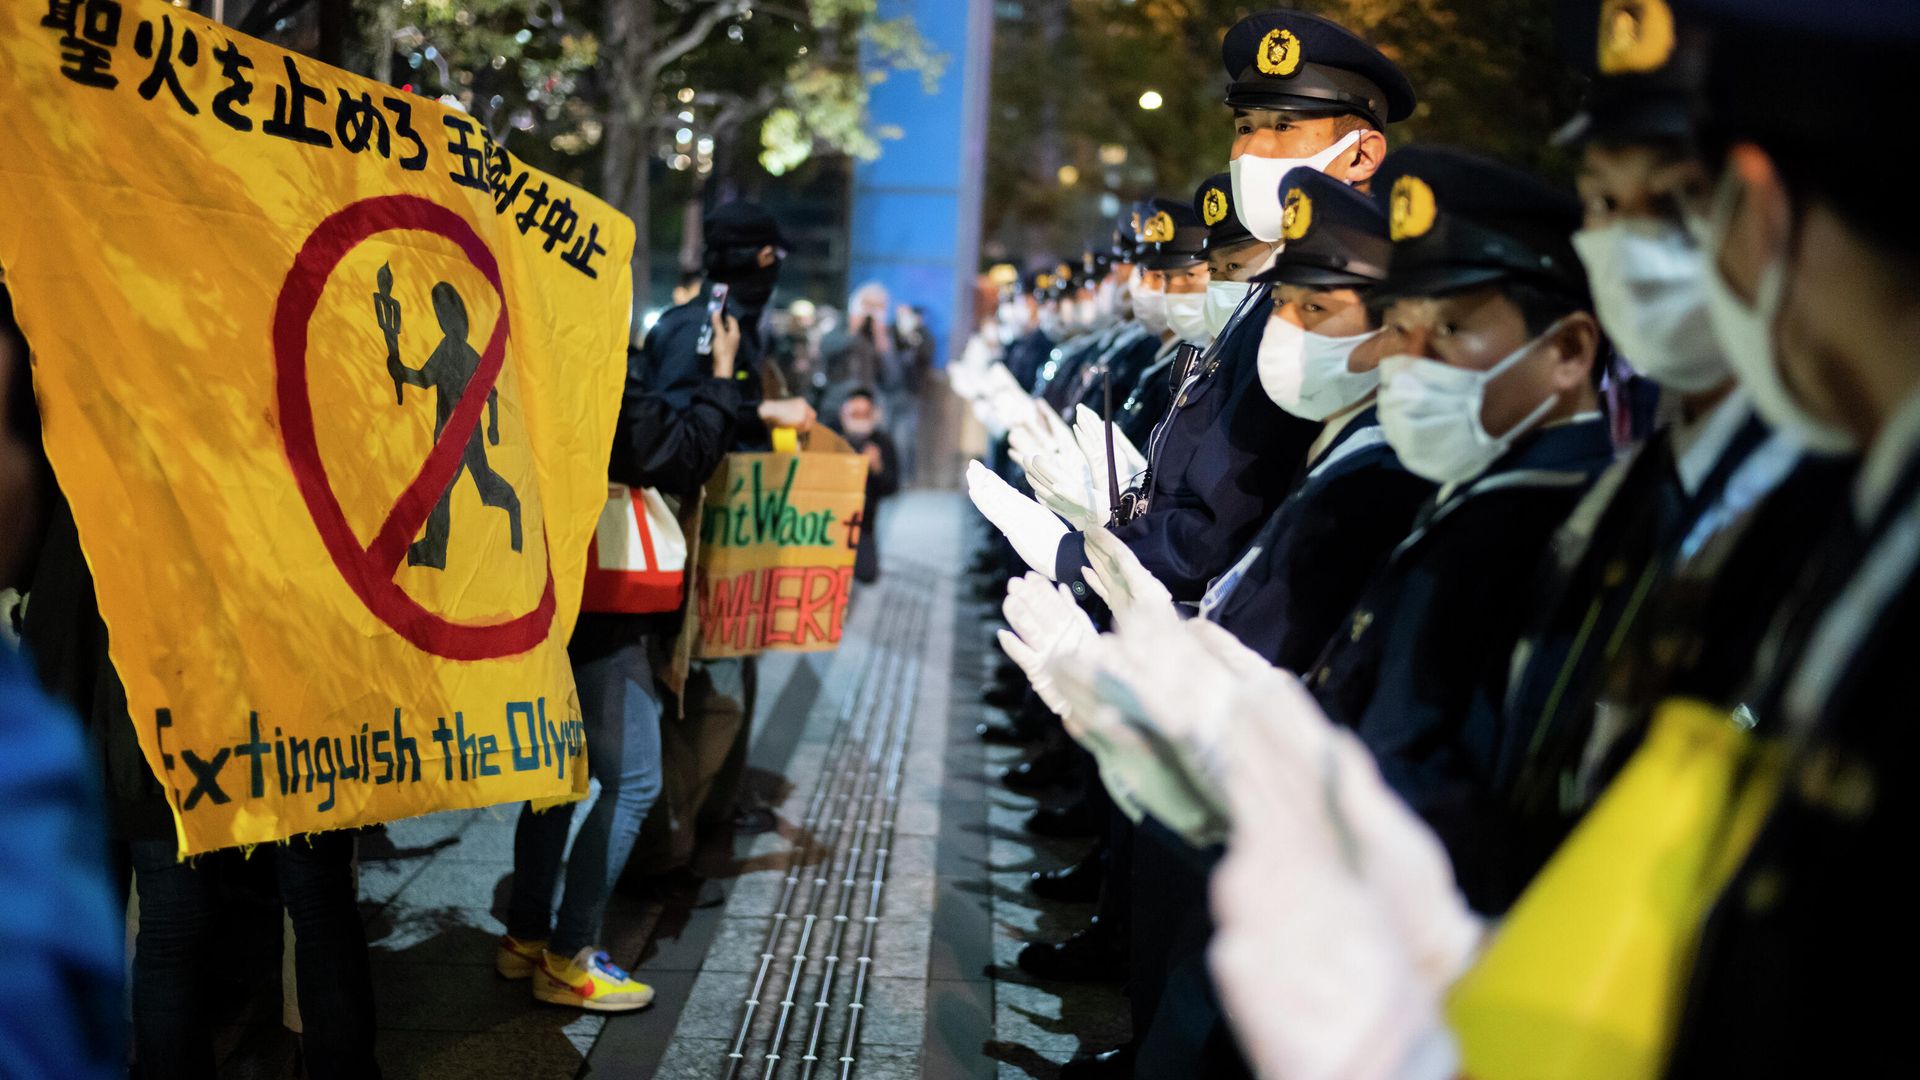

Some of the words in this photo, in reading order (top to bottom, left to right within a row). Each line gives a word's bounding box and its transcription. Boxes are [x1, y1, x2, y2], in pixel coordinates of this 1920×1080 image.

[41, 0, 429, 171] 聖火を止めろ
[752, 458, 837, 547] Want
[432, 711, 501, 782] the
